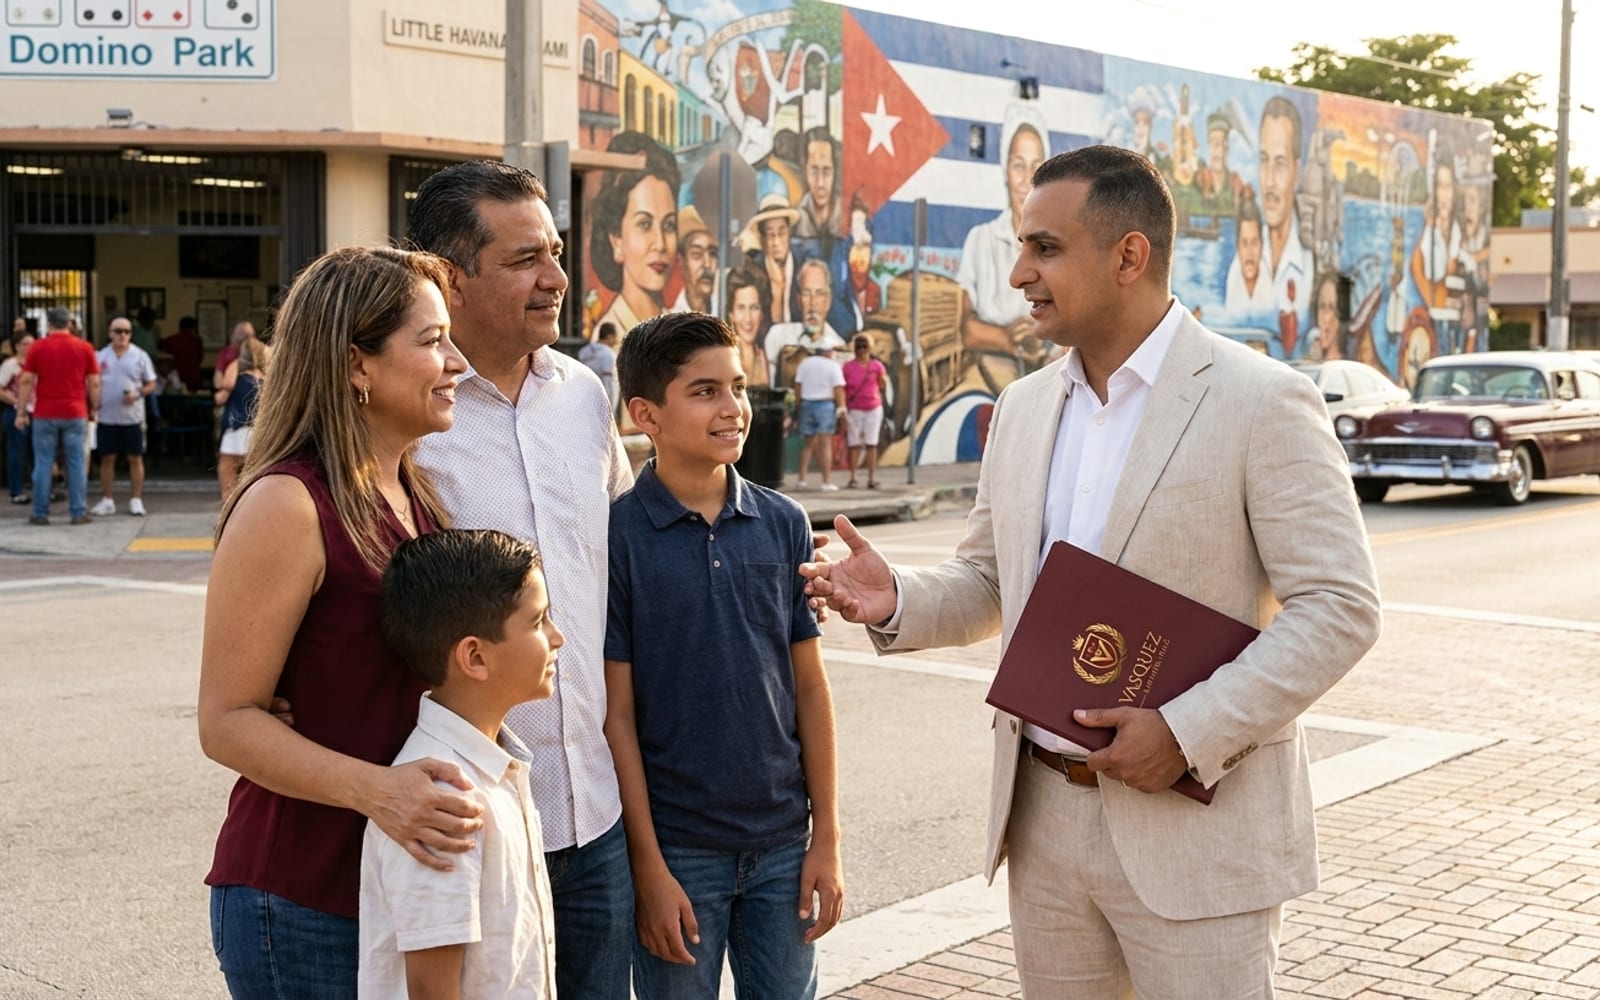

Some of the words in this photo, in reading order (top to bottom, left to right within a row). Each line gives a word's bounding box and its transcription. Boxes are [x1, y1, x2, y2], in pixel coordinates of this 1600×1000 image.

[9, 35, 153, 66] Domino
[173, 37, 255, 67] Park
[391, 18, 444, 42] LITTLE
[543, 40, 569, 59] AMI
[1118, 631, 1162, 703] VASQUEZ
